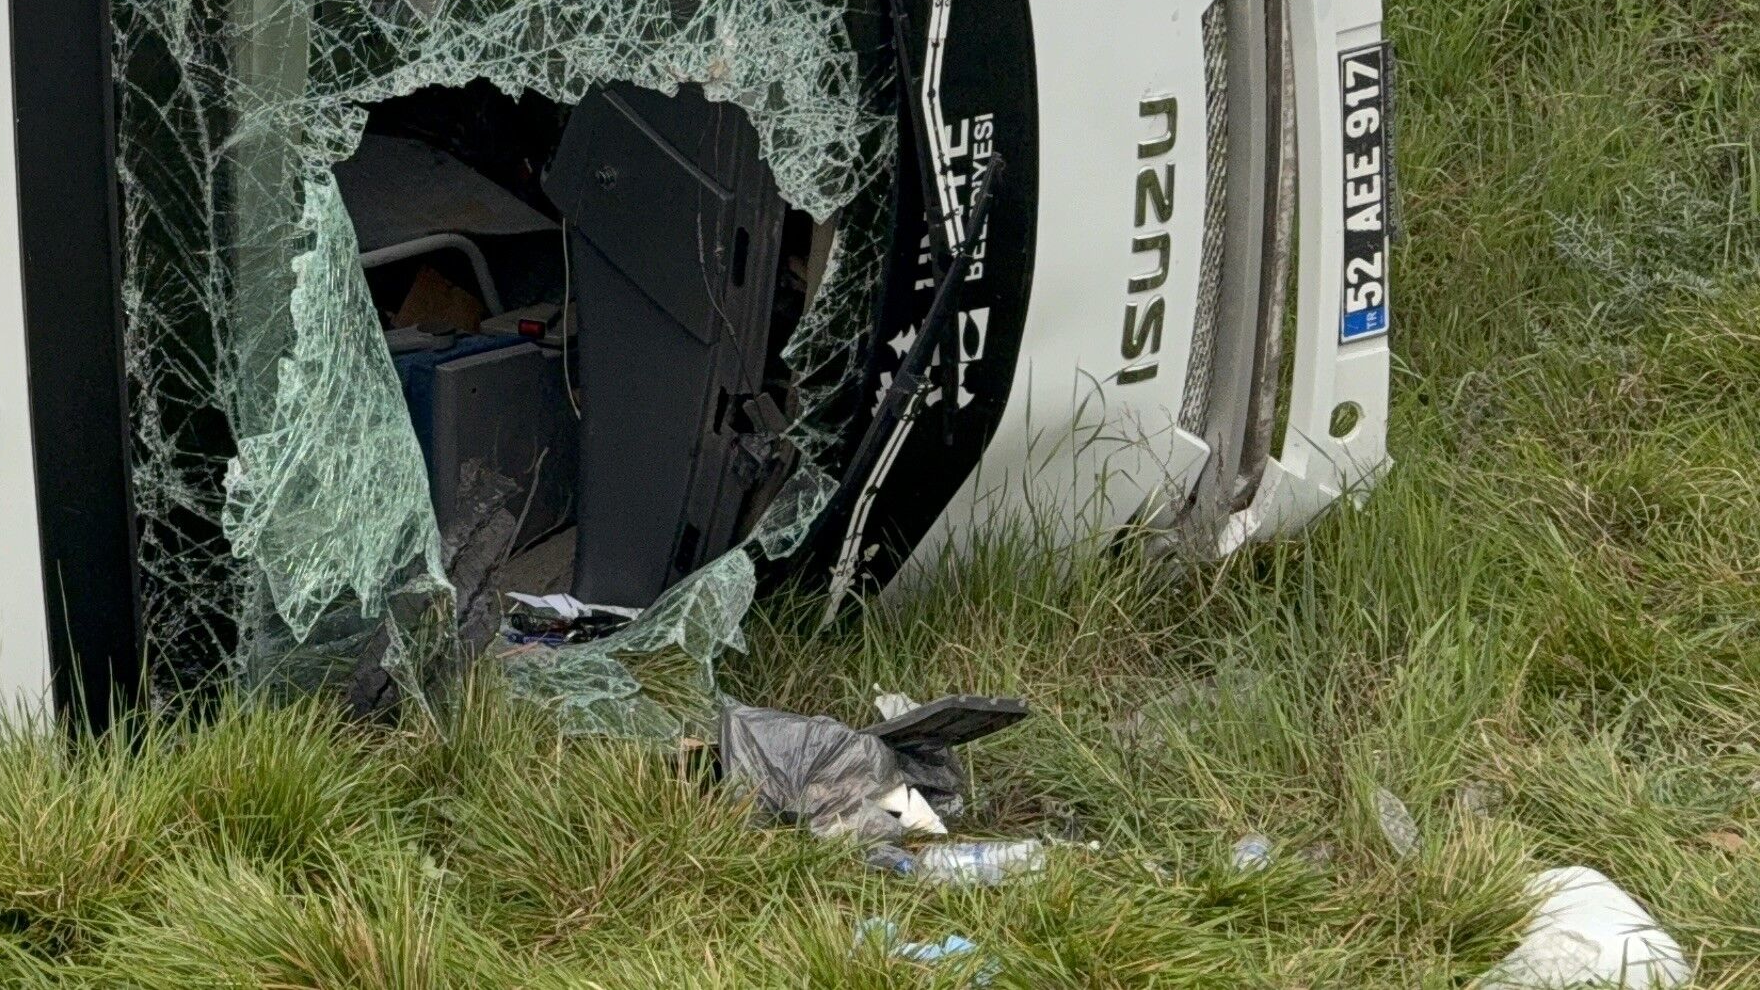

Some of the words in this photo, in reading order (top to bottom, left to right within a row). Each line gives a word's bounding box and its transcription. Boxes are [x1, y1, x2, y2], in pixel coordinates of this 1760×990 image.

[1345, 59, 1380, 139] 917
[1346, 146, 1382, 231] AEE
[1116, 92, 1178, 386] ISUZU
[1346, 251, 1383, 313] 52
[1366, 310, 1378, 330] TR
